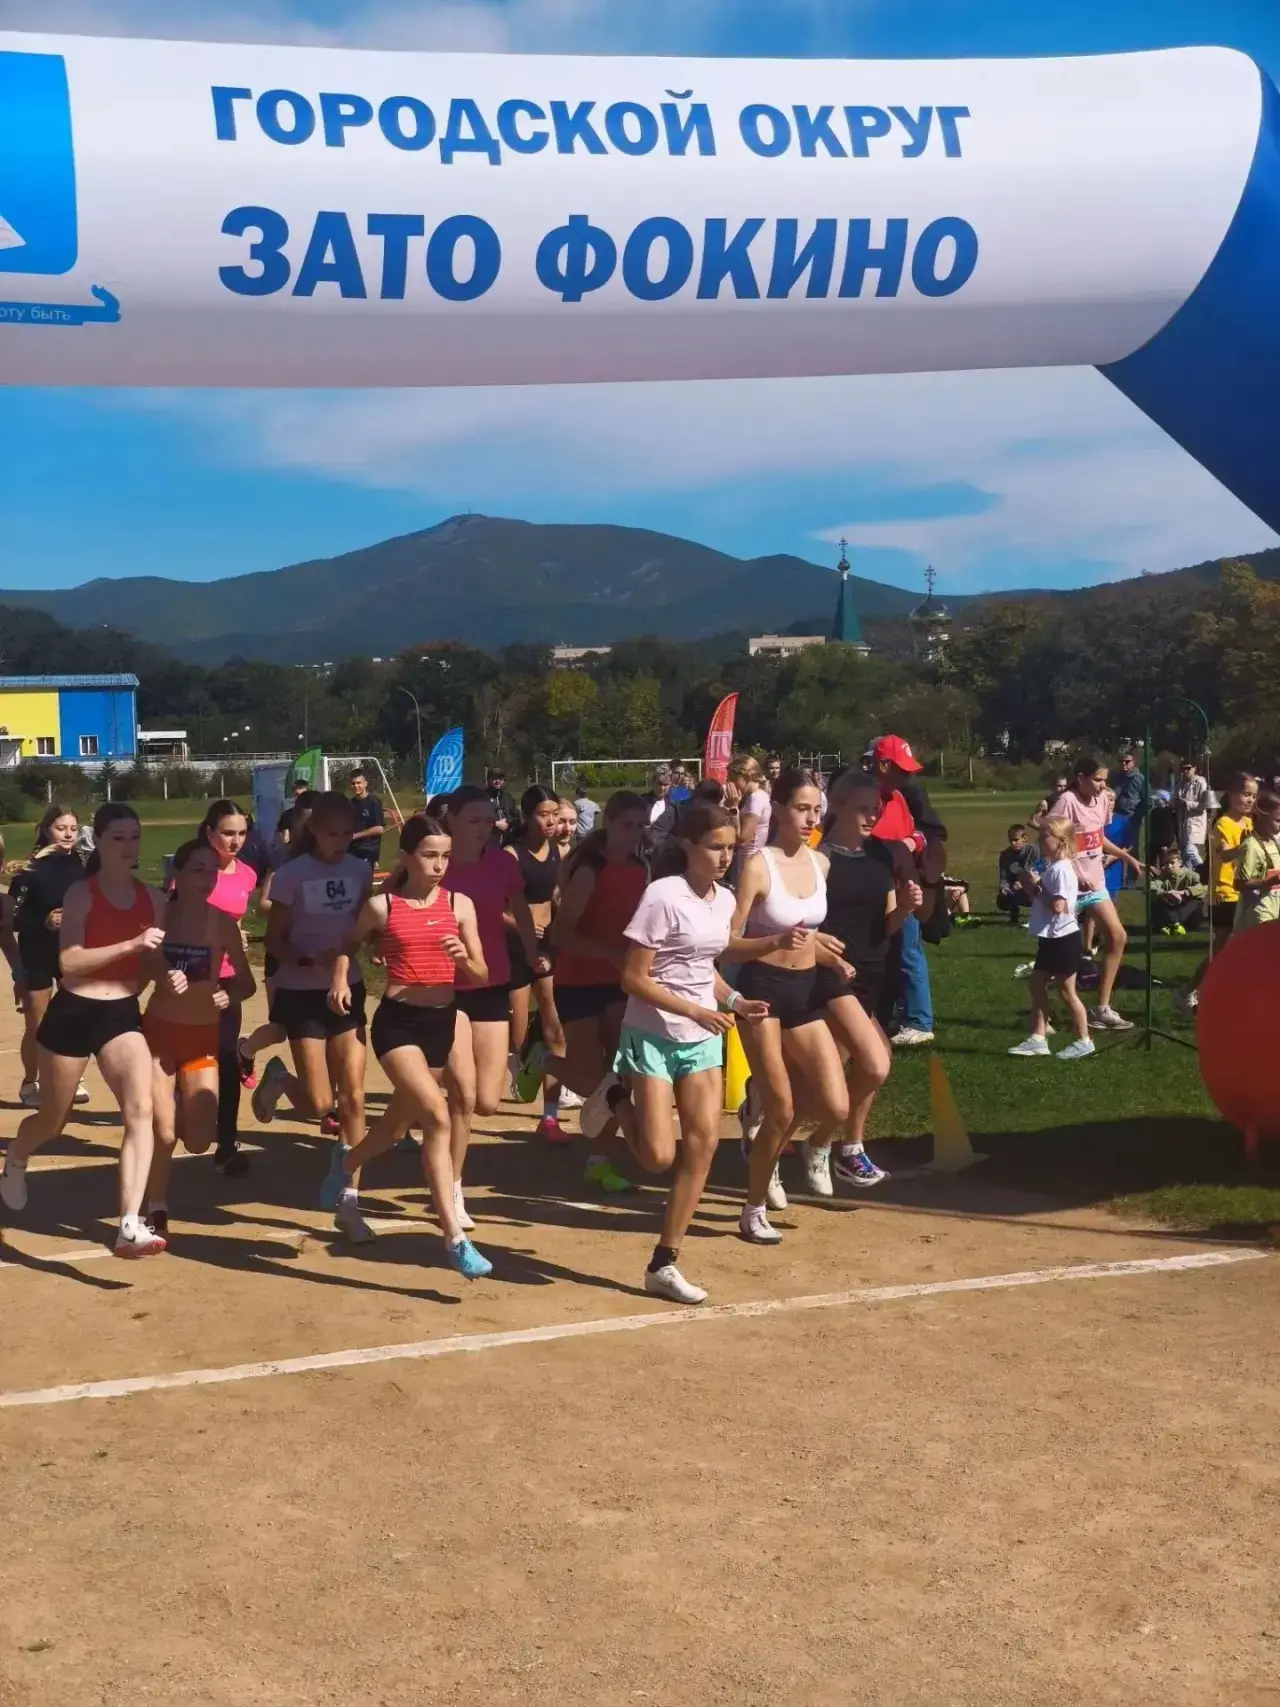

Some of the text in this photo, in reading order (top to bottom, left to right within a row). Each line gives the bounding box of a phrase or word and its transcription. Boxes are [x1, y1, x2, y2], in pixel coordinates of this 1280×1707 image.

[211, 87, 970, 165] ГОРОДСКОЙ ОКРУГ
[218, 205, 979, 303] ЗАТО ФОКИНО
[31, 306, 71, 320] быть
[326, 880, 346, 900] 64
